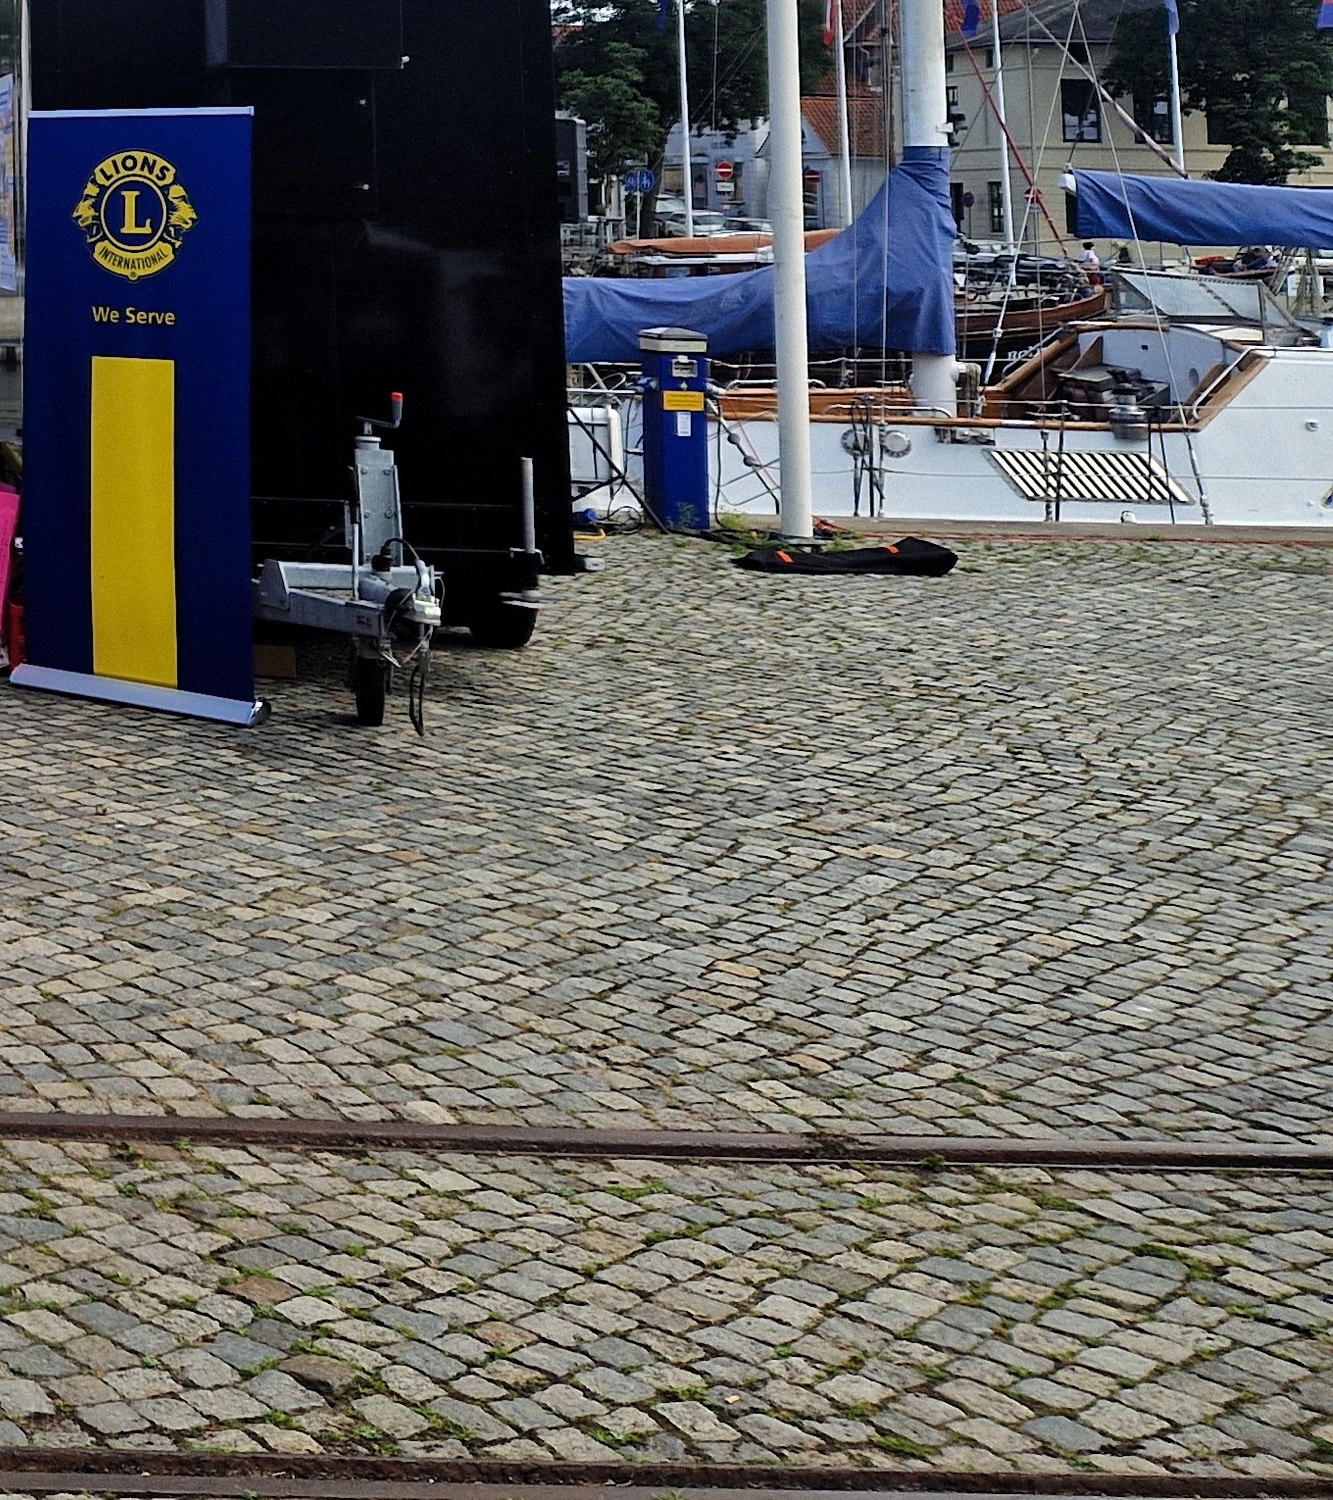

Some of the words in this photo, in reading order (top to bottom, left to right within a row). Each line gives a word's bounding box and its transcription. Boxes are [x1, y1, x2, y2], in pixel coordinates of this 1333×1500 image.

[99, 155, 171, 182] LIONS
[120, 190, 152, 234] L
[98, 245, 169, 270] INTERNATIONAL
[91, 305, 120, 323] We
[125, 307, 176, 326] Serve
